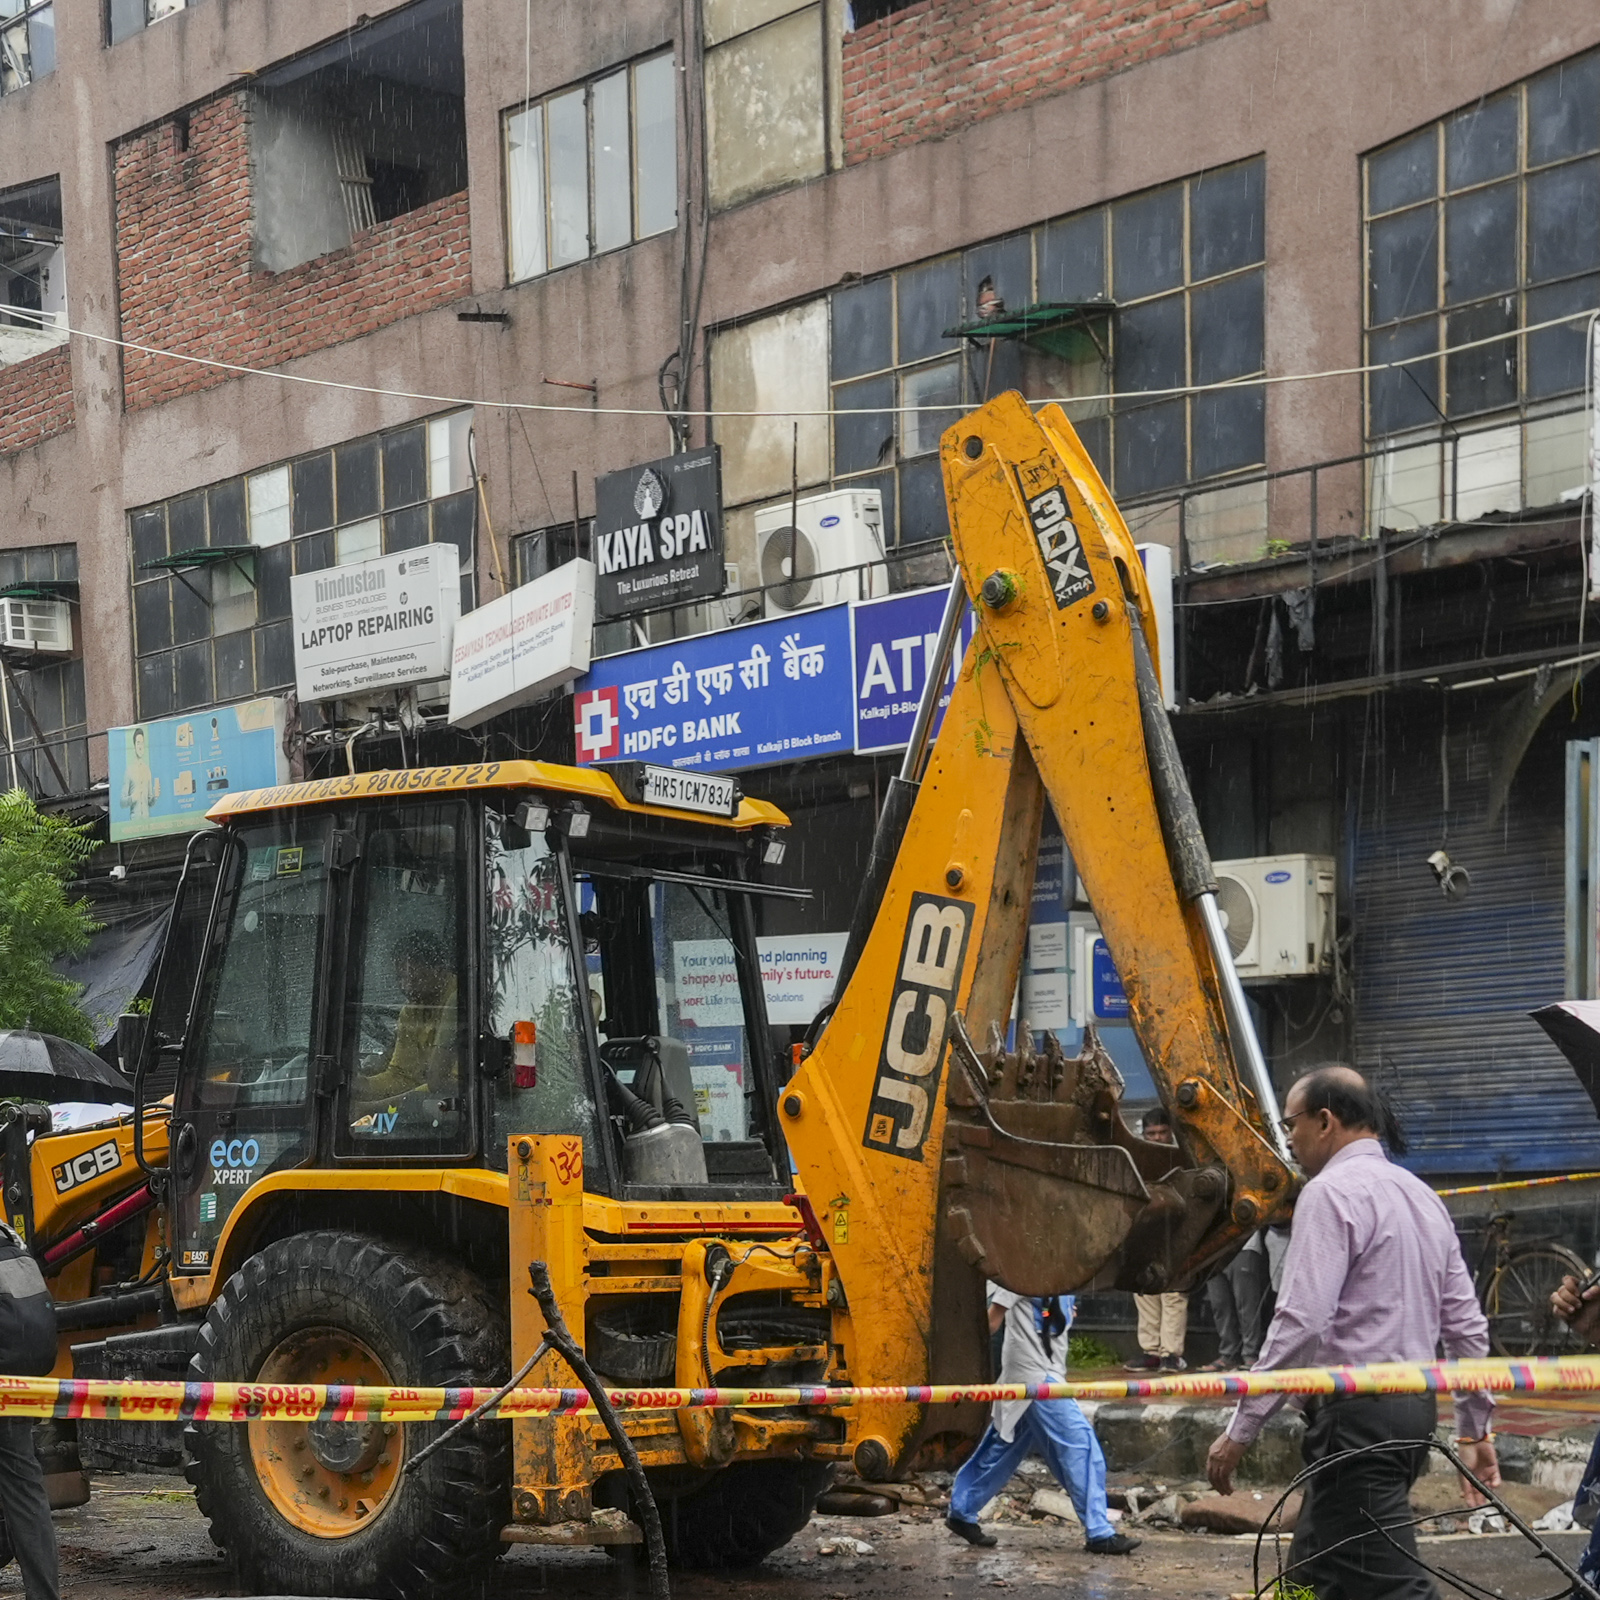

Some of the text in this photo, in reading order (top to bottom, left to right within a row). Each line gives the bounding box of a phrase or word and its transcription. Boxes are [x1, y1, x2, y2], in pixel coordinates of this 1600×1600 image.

[597, 509, 708, 576] KAYA SPA
[1031, 489, 1089, 592] 3DX
[315, 568, 386, 603] hindustan
[617, 581, 631, 596] The
[633, 573, 669, 592] Luxurious
[670, 564, 700, 584] Retreat
[1056, 577, 1093, 603] XTRA
[316, 592, 388, 615] BUSINESS TECHNOLOGIES
[301, 605, 434, 650] LAPTOP REPAIRING
[370, 652, 417, 667] Maintenance,
[312, 665, 428, 693] Networking, Surveillance Services
[623, 632, 825, 720] एच डी एफ सी बैंक
[860, 703, 890, 720] Kalkaji
[623, 711, 742, 755] HDFC BANK
[756, 729, 842, 755] Kalkaji B Block Branch
[231, 793, 250, 809] M.
[366, 763, 501, 793] 9818562729
[681, 948, 828, 967] Your planning
[682, 967, 834, 988] shape future.
[684, 997, 704, 1007] HDFC
[766, 992, 804, 1003] Solutions
[877, 902, 966, 1150] JCB
[694, 1042, 733, 1053] HDFC BANK
[209, 1138, 260, 1168] eco
[56, 1142, 120, 1191] JCB
[212, 1169, 253, 1185] XPERT
[237, 1385, 316, 1405] CROSS
[1451, 1374, 1513, 1390] POLICE
[286, 1405, 318, 1417] DO
[609, 1390, 682, 1410] CROSS
